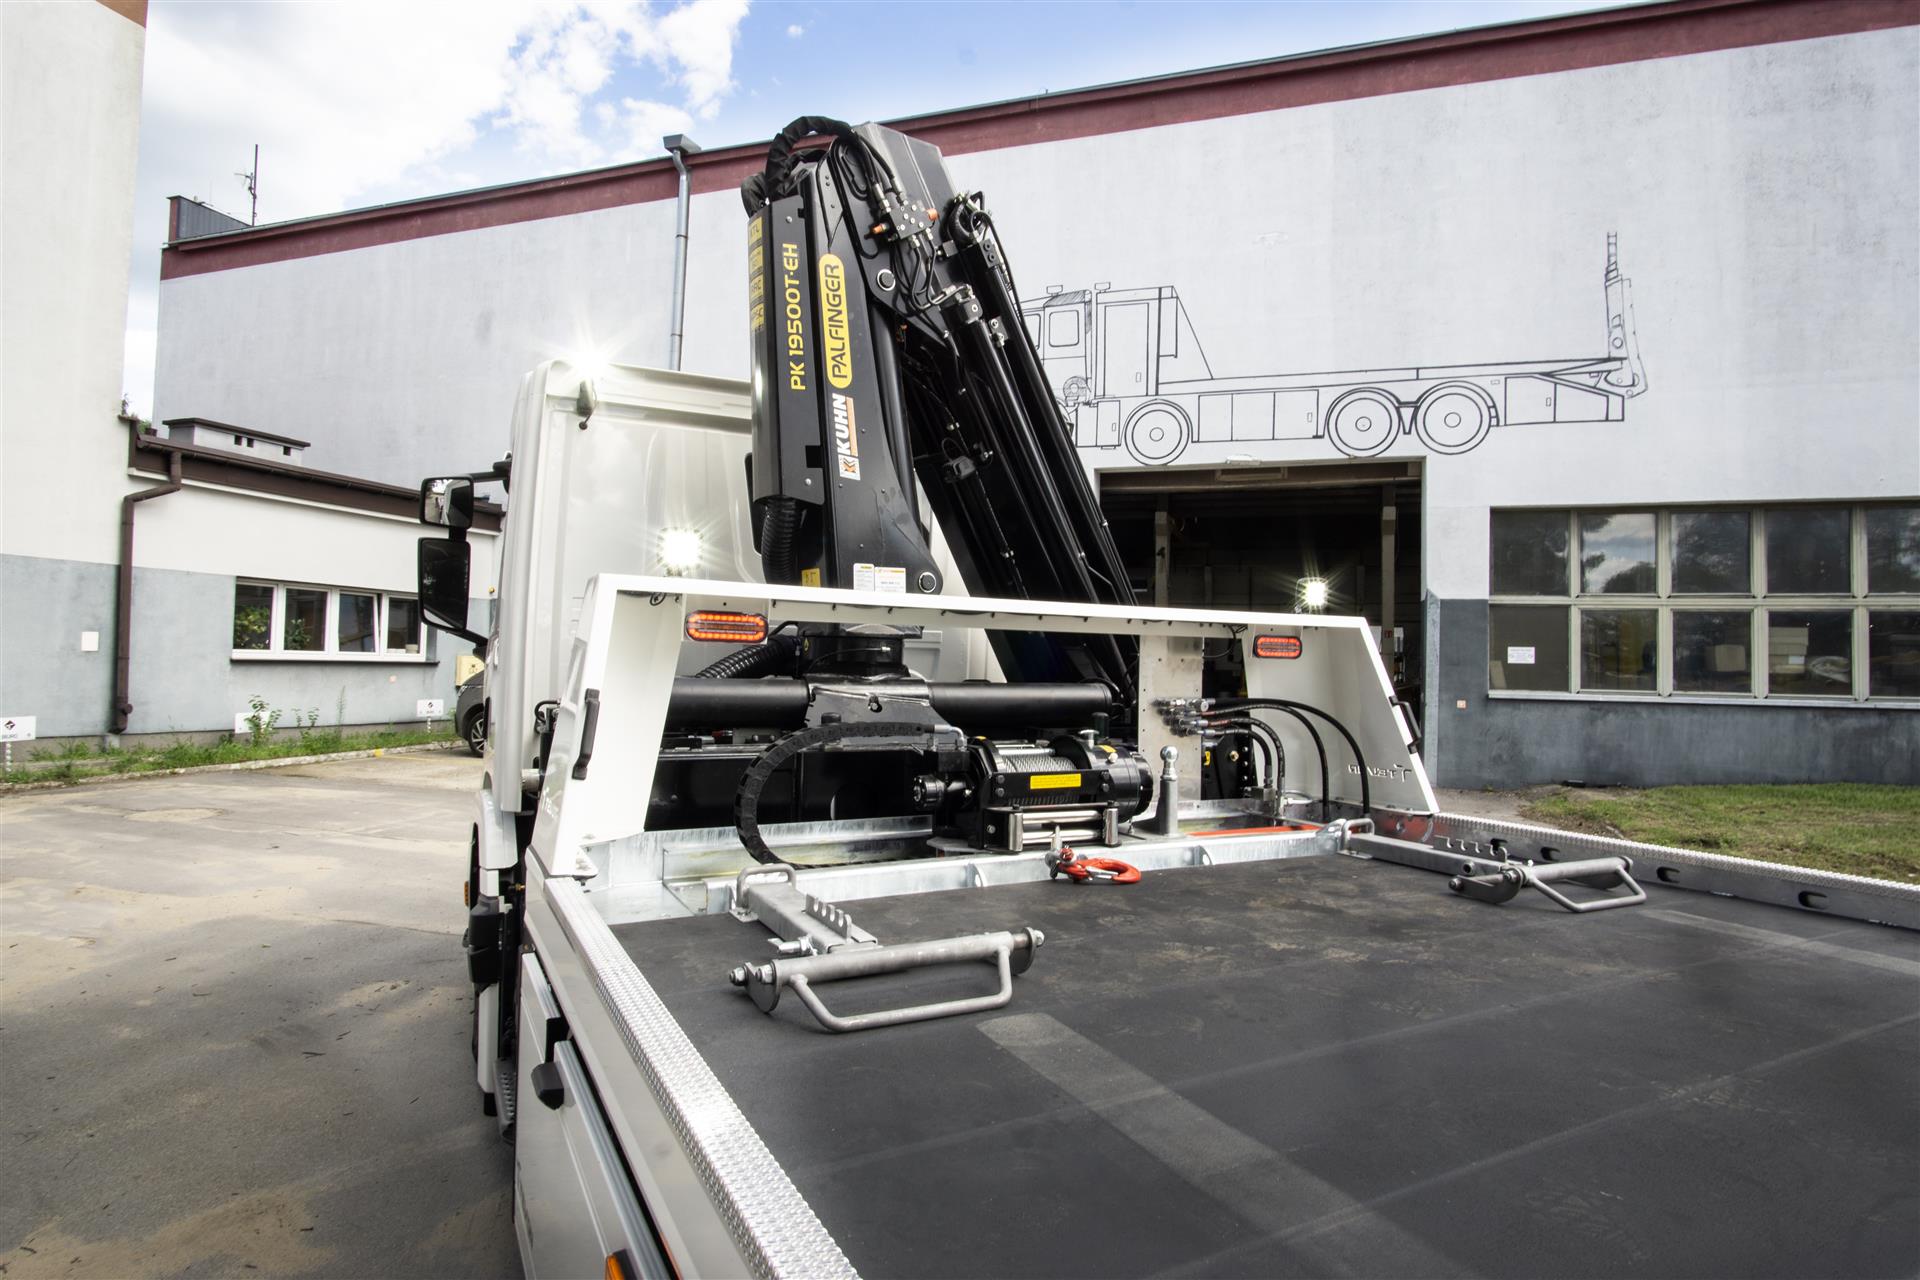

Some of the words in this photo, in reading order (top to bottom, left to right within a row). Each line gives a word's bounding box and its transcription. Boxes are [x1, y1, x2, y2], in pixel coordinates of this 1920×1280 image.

[824, 263, 848, 379] PALFINGER
[790, 361, 806, 390] PK
[832, 392, 851, 456] KUHN
